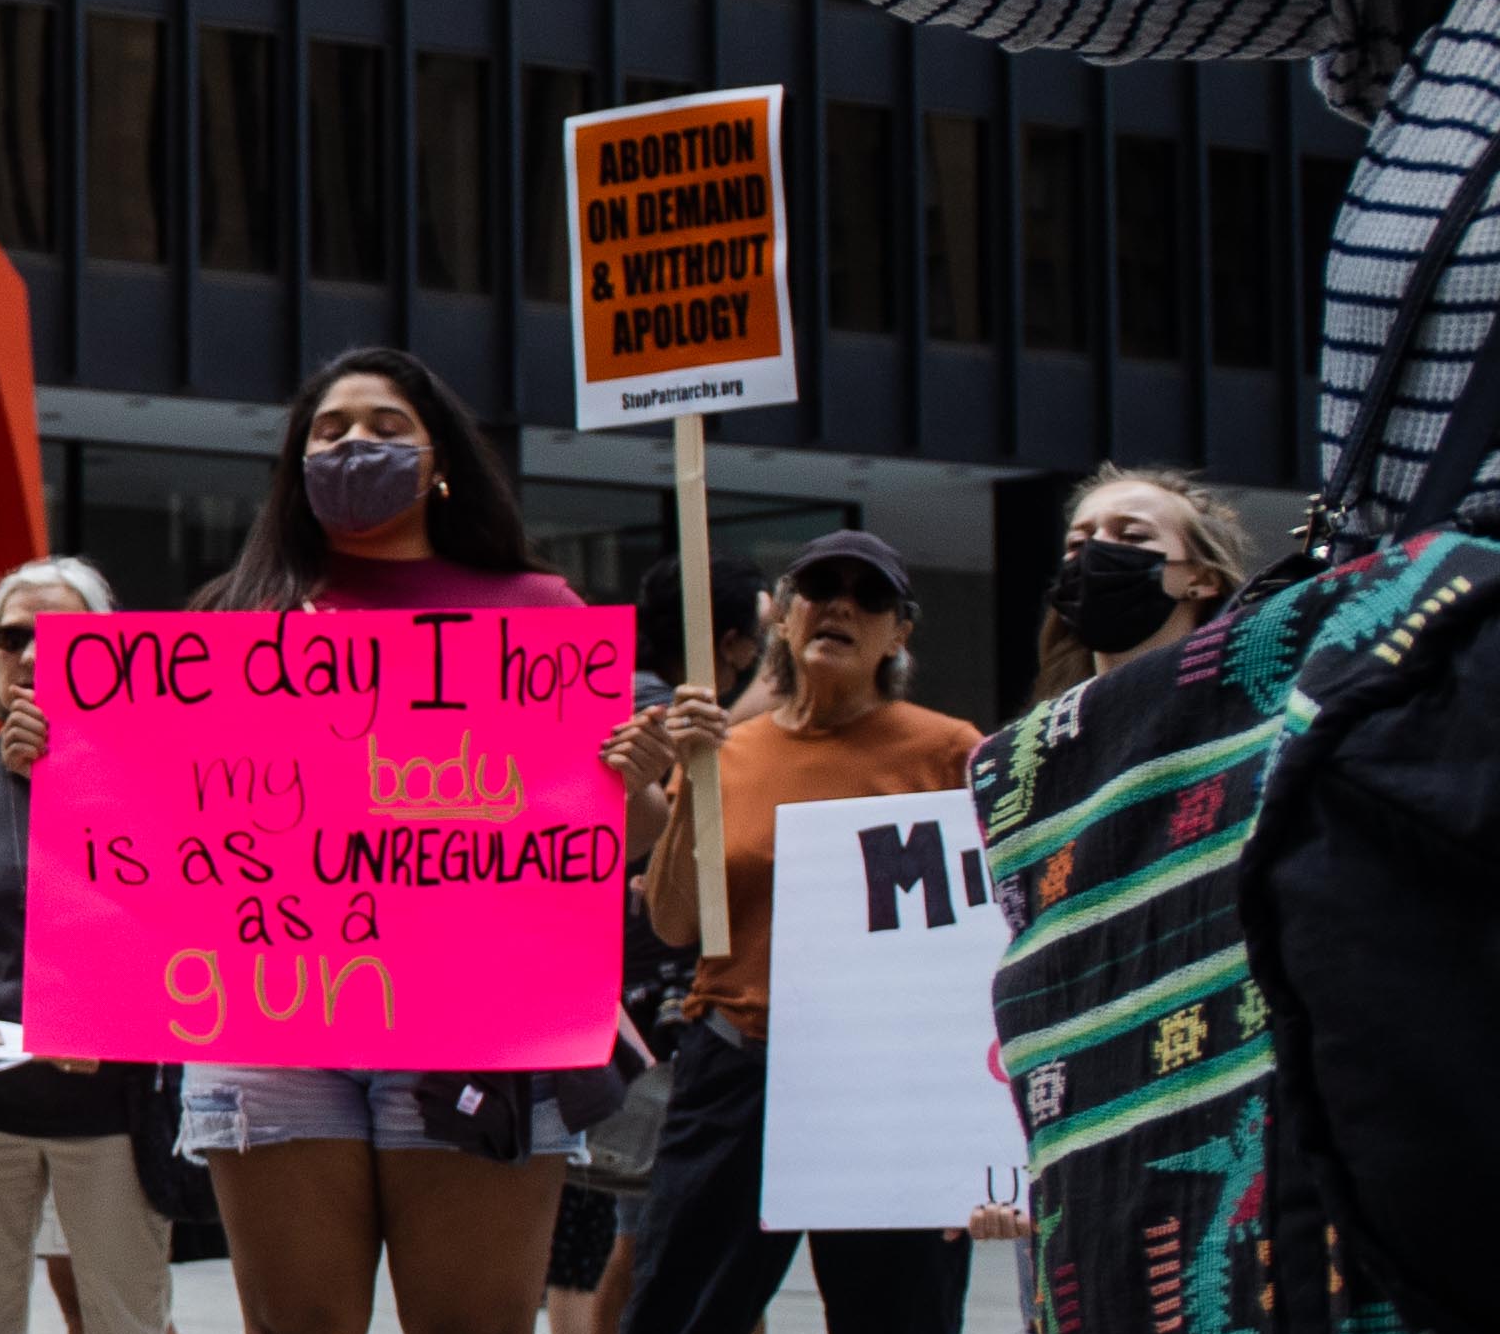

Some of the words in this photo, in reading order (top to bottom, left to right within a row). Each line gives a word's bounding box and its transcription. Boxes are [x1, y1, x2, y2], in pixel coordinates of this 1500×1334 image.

[600, 117, 755, 188] ABORTION
[587, 195, 628, 245] ON
[637, 174, 766, 237] DEMAND
[592, 261, 614, 302] &
[622, 234, 768, 297] WITHOUT
[612, 291, 750, 356] APOLOGY
[621, 379, 744, 411] StopPatriarchy.org
[244, 611, 381, 740] day
[410, 613, 473, 710] I
[500, 617, 622, 721] hope
[192, 756, 305, 833] my
[367, 729, 525, 821] body
[85, 827, 150, 885] is
[181, 831, 274, 885] as
[312, 824, 621, 887] UNREGULATED
[237, 895, 313, 947] as
[342, 890, 380, 944] a
[165, 948, 395, 1046] gun
